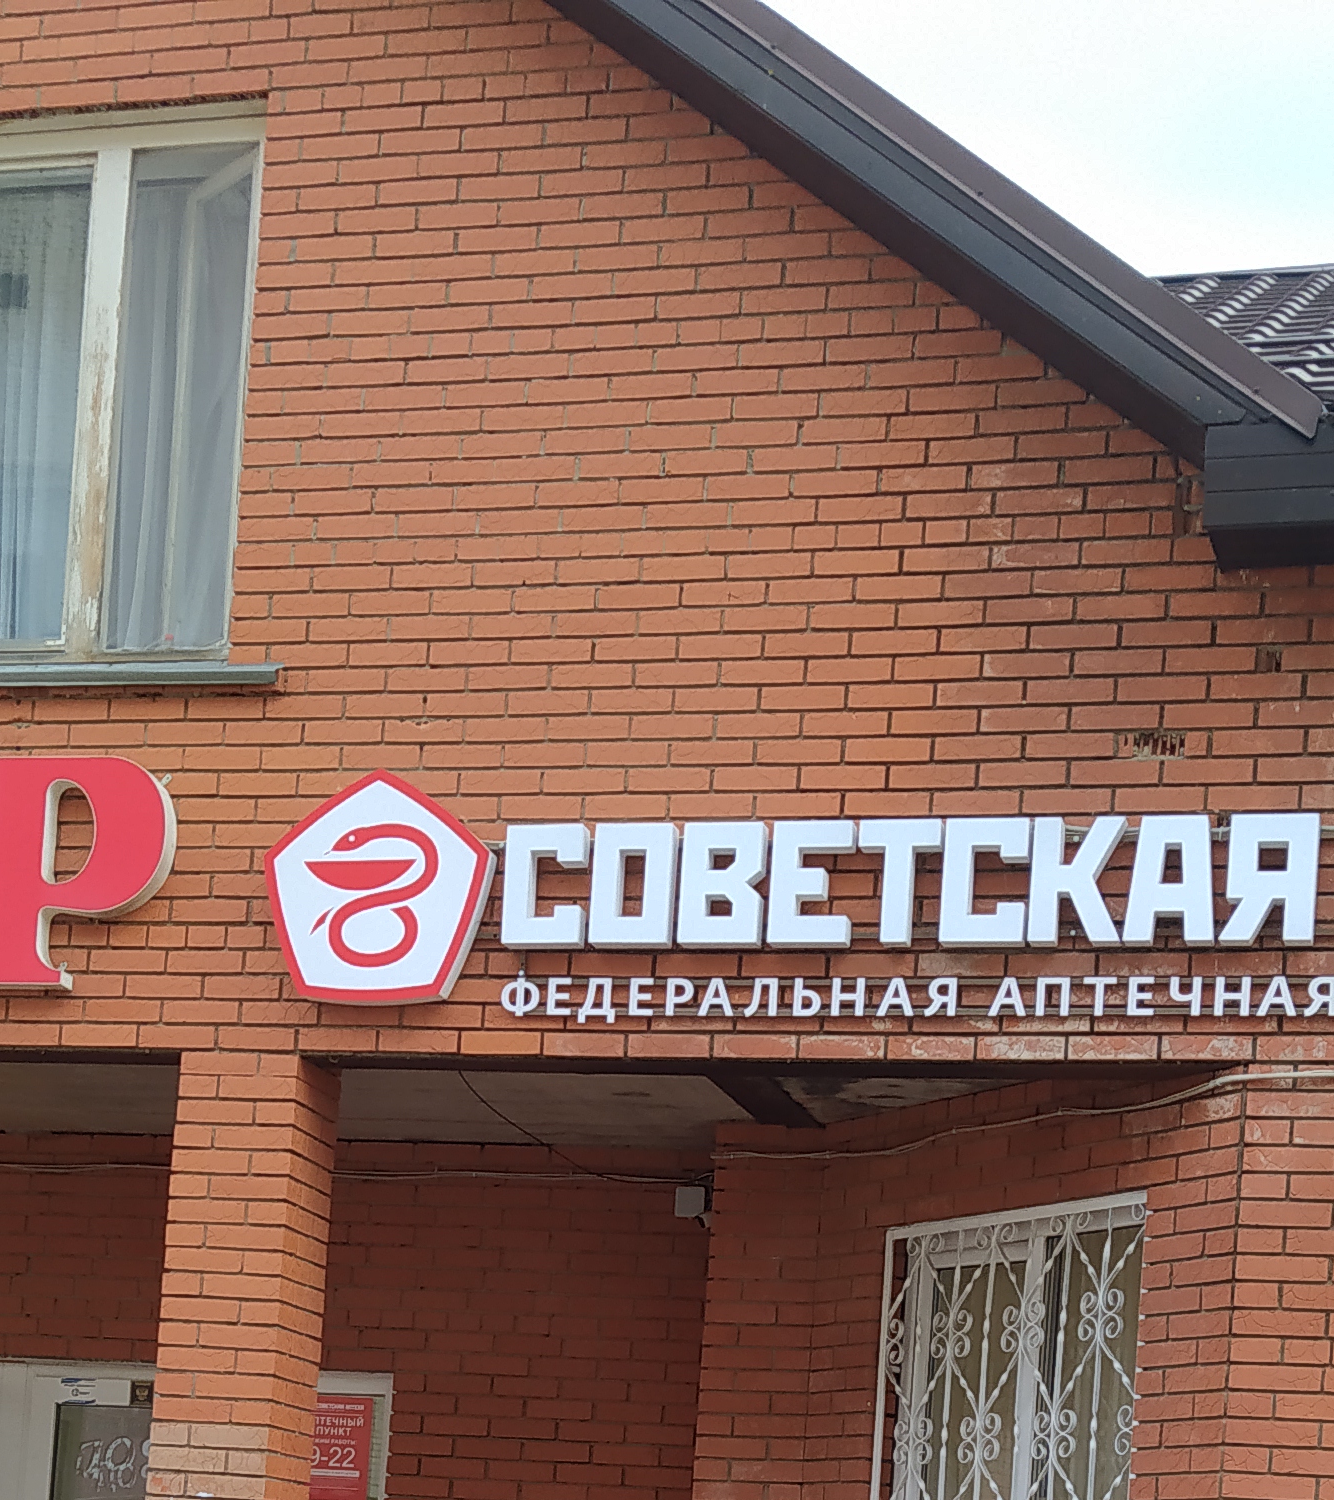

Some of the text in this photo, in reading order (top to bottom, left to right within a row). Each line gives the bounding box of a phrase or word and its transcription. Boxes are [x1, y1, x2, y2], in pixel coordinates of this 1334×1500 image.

[500, 811, 1321, 949] СОВЕТСКАЯ
[500, 975, 958, 1024] ФЕДЕРАЛЬНАЯ
[315, 1415, 365, 1427] ПТЕЧНЫЙ
[315, 1425, 352, 1437] ПУНКТ
[311, 1446, 356, 1468] 9-22
